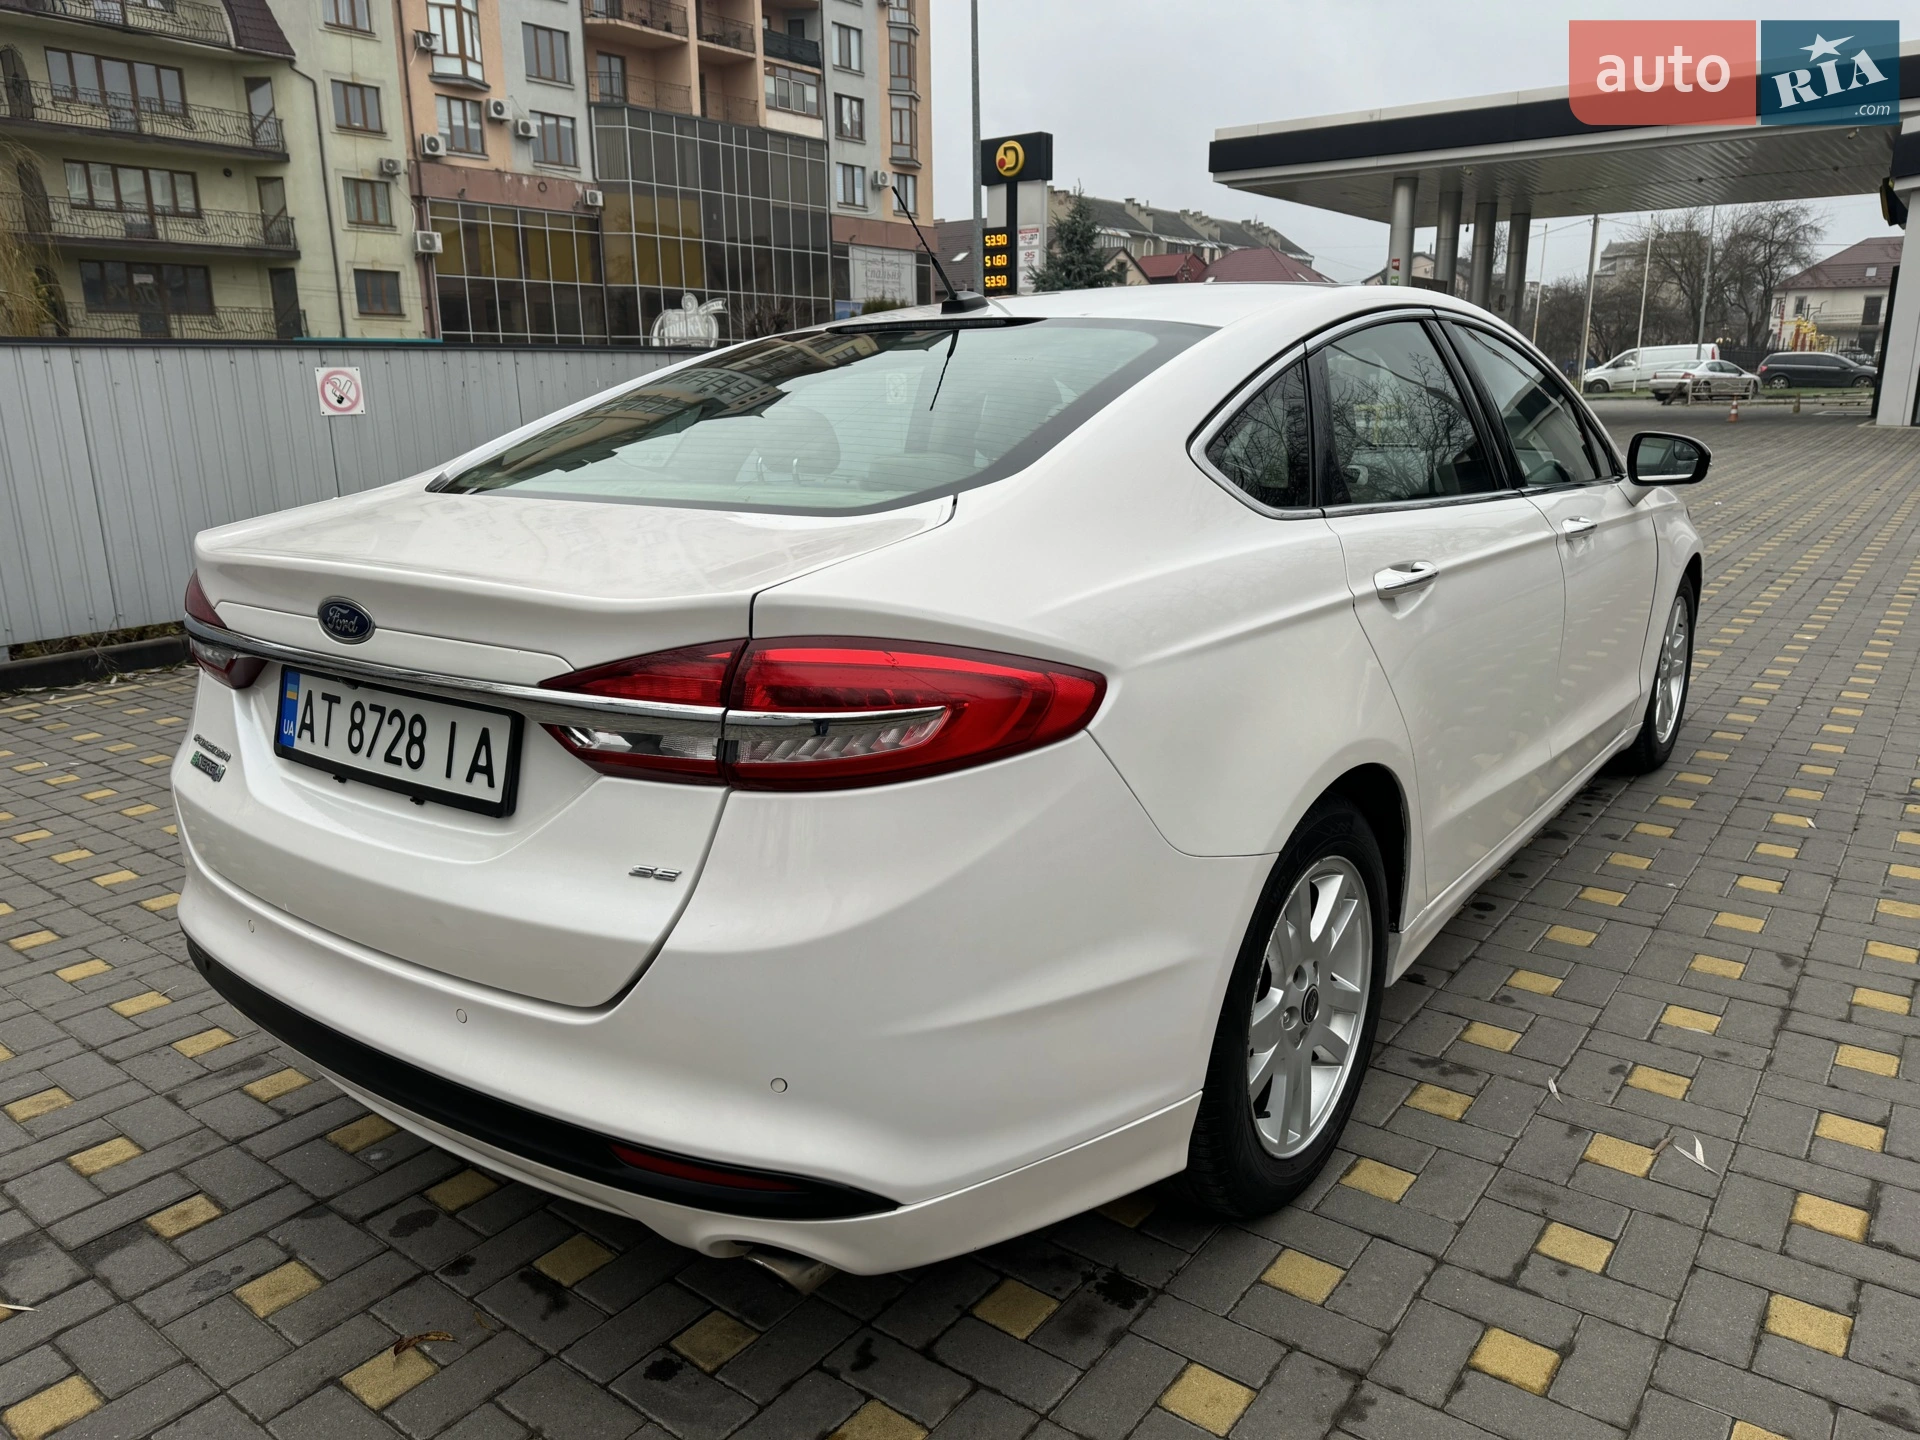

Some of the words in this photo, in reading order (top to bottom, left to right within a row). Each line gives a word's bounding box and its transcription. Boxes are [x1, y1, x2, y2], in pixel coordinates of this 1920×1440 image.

[326, 605, 359, 633] Ford
[283, 719, 294, 737] UA
[297, 689, 342, 747] AT
[347, 700, 427, 770] 8728
[445, 721, 496, 789] IA
